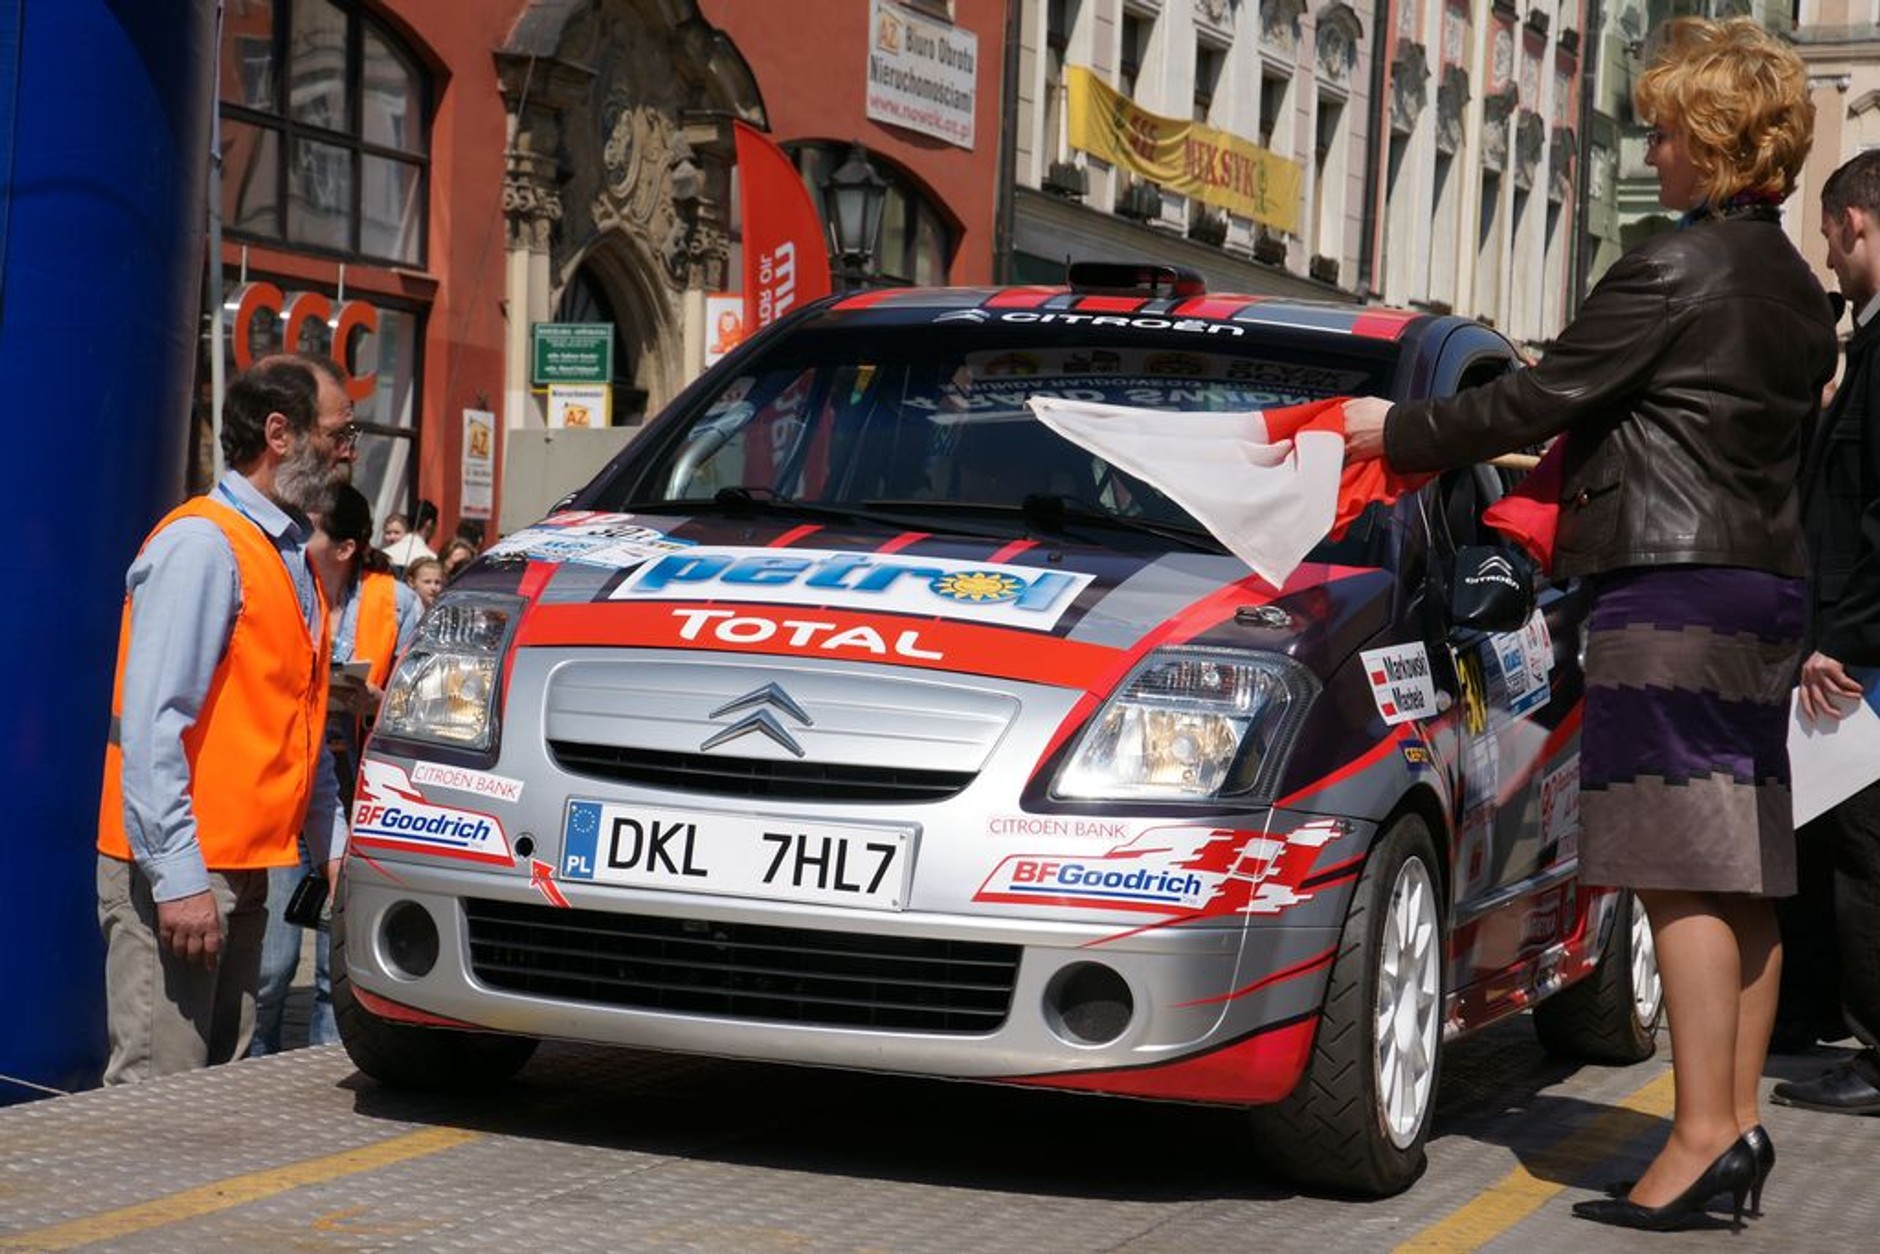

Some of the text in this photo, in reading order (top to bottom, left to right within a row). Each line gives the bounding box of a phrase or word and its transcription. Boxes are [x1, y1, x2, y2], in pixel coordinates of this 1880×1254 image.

[905, 26, 974, 75] Biuro Obrotu
[1001, 311, 1245, 336] CITROËN
[233, 281, 379, 401] CCC
[566, 410, 588, 426] AZ
[470, 430, 488, 455] AZ
[629, 554, 1077, 612] petrol
[1465, 575, 1520, 590] CITROËN
[671, 608, 944, 661] TOTAL
[475, 776, 519, 800] BANK
[355, 804, 491, 841] BFGoodrich
[1075, 822, 1127, 839] BANK
[567, 855, 592, 873] PL
[607, 816, 897, 894] DKL 7HL7
[1011, 860, 1202, 896] BFGoodrich
